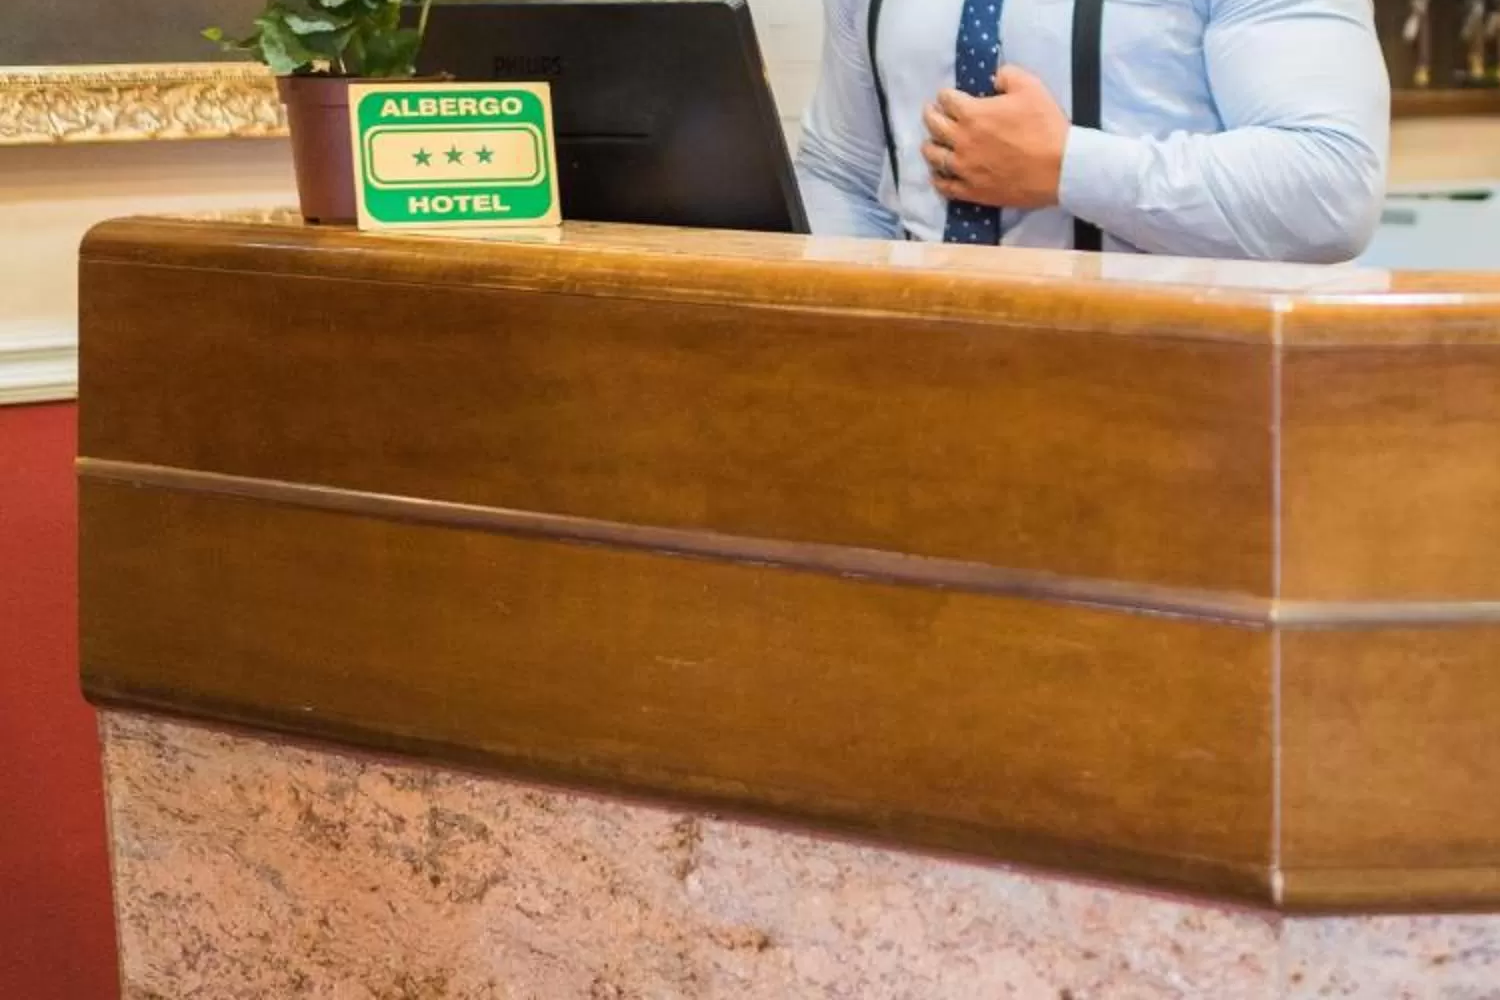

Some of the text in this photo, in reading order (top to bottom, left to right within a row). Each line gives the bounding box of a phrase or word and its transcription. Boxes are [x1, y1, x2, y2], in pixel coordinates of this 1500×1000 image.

[494, 55, 562, 75] PHILIPS
[380, 96, 523, 117] ALBERGO
[407, 193, 511, 214] HOTEL
